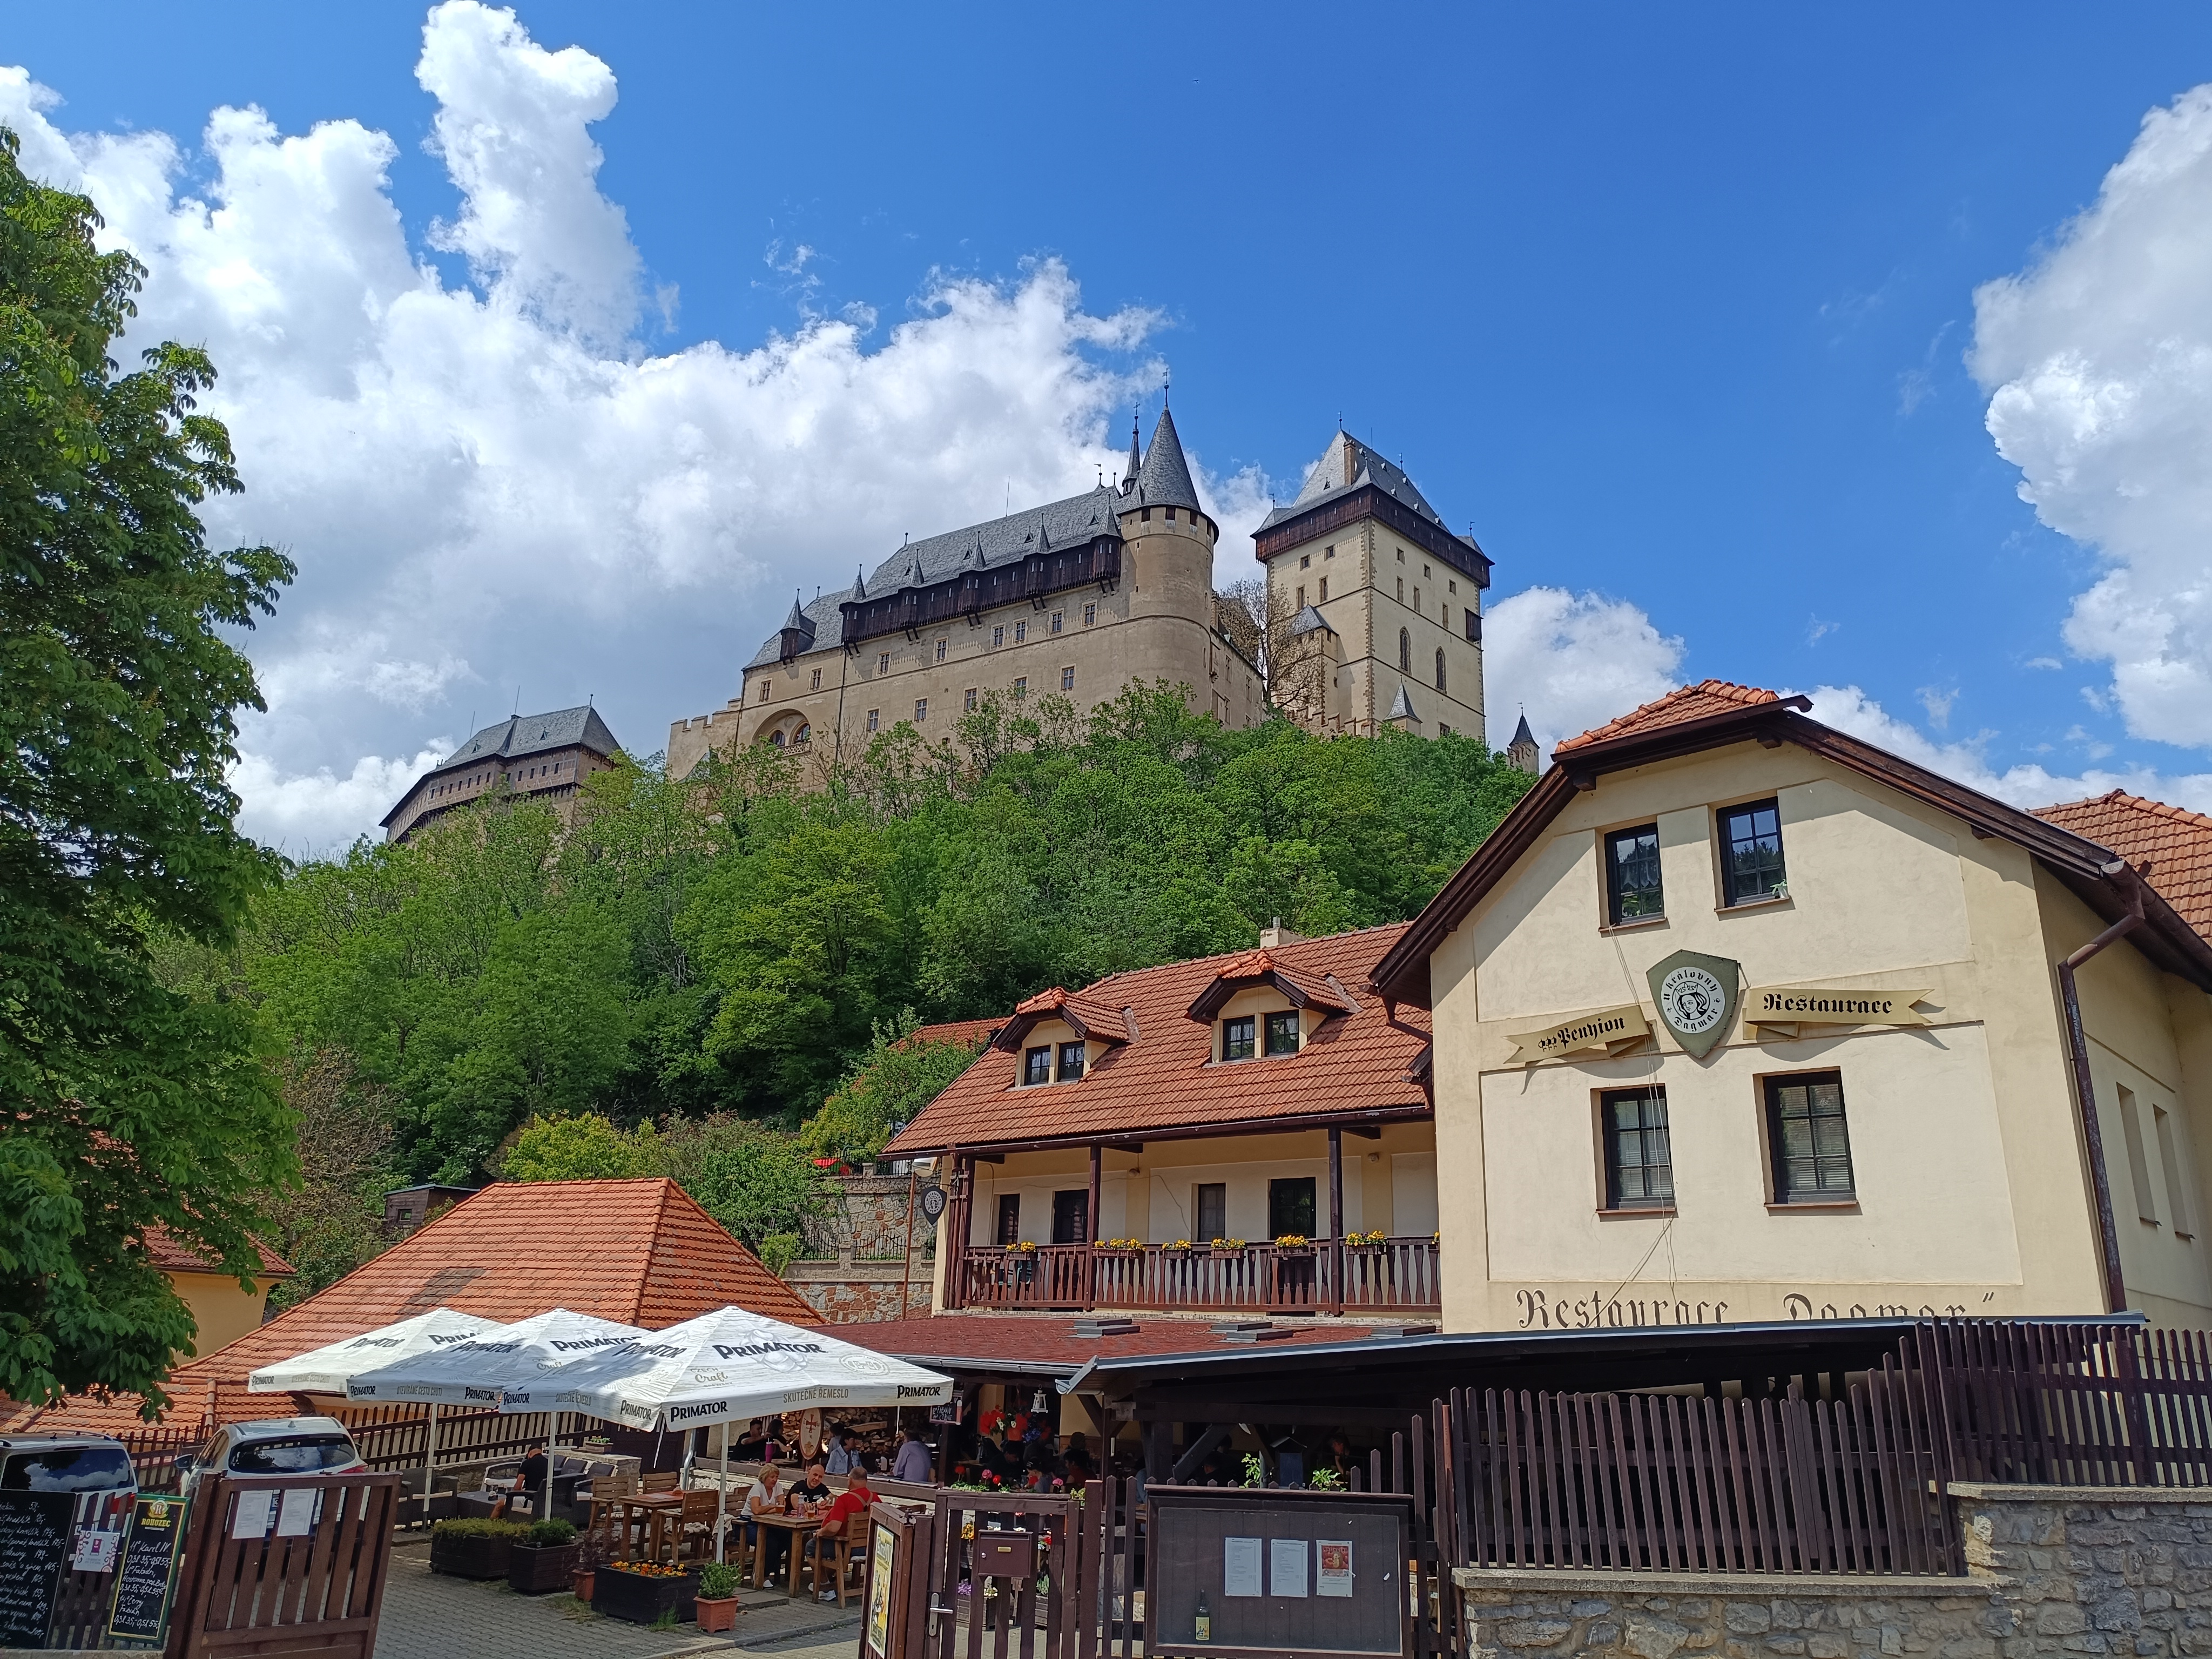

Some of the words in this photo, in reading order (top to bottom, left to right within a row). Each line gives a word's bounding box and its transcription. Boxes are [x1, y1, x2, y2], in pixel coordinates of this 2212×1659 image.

[1764, 993, 1892, 1014] Restaurace
[1674, 1008, 1718, 1031] Dagmar
[1516, 1290, 1728, 1328] Restaurace
[612, 1343, 687, 1358] PRIMATOR
[712, 1342, 828, 1359] PRIMATOR
[252, 1375, 274, 1386] PRIMATOR
[694, 1372, 728, 1383] Craft
[350, 1385, 376, 1397] PRIMATOR
[464, 1386, 495, 1401] PRIMATOR
[503, 1392, 530, 1405] PRIMATOR
[783, 1388, 817, 1403] SKUTEČNÉ
[818, 1387, 849, 1398] ŘEMESLO
[897, 1385, 941, 1399] PRIMATOR
[620, 1400, 651, 1420] PRIMATOR
[670, 1401, 728, 1422] PRIMATOR
[141, 1518, 171, 1527] ROHOZEC
